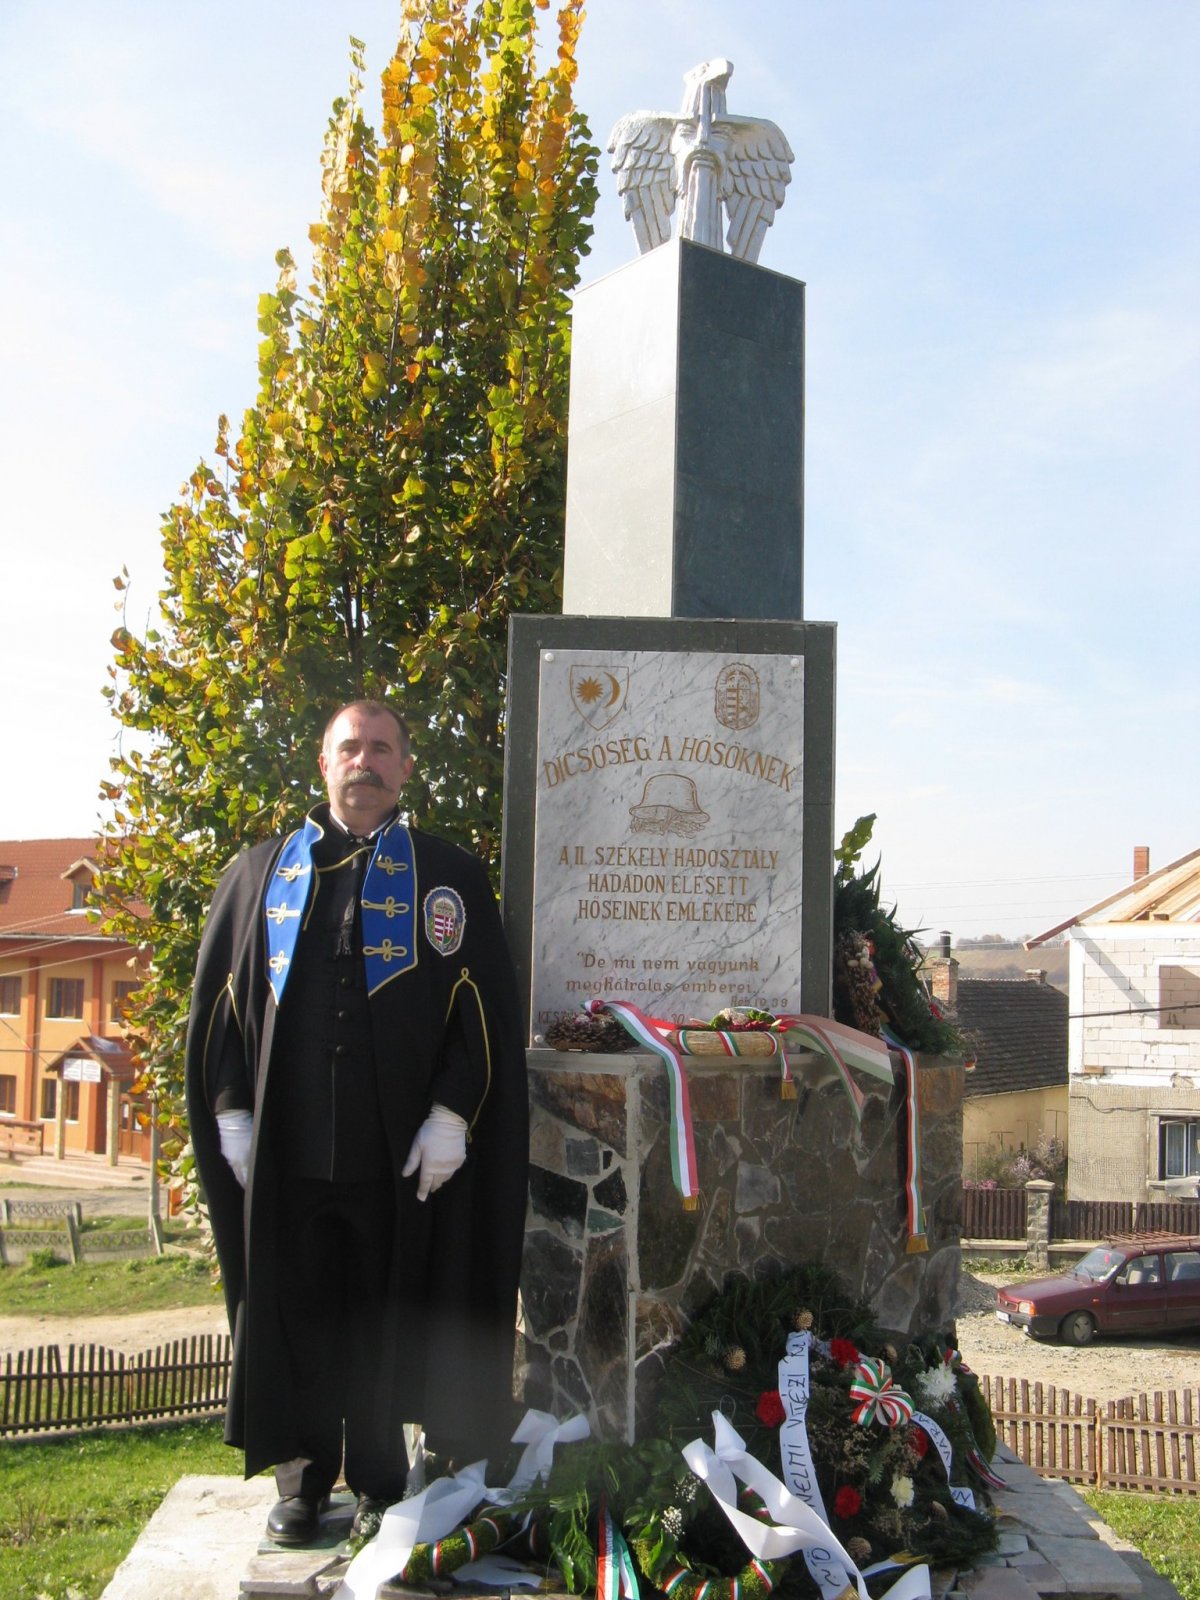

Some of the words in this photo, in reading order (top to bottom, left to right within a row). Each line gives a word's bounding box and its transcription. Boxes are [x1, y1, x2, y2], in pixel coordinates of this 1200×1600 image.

[657, 735, 673, 762] A
[558, 846, 569, 865] A
[595, 841, 669, 867] SZÉKELY
[674, 846, 779, 869] HADOSZTÁLY
[614, 956, 636, 969] mi
[643, 959, 679, 971] nem
[687, 957, 759, 974] vagyunk
